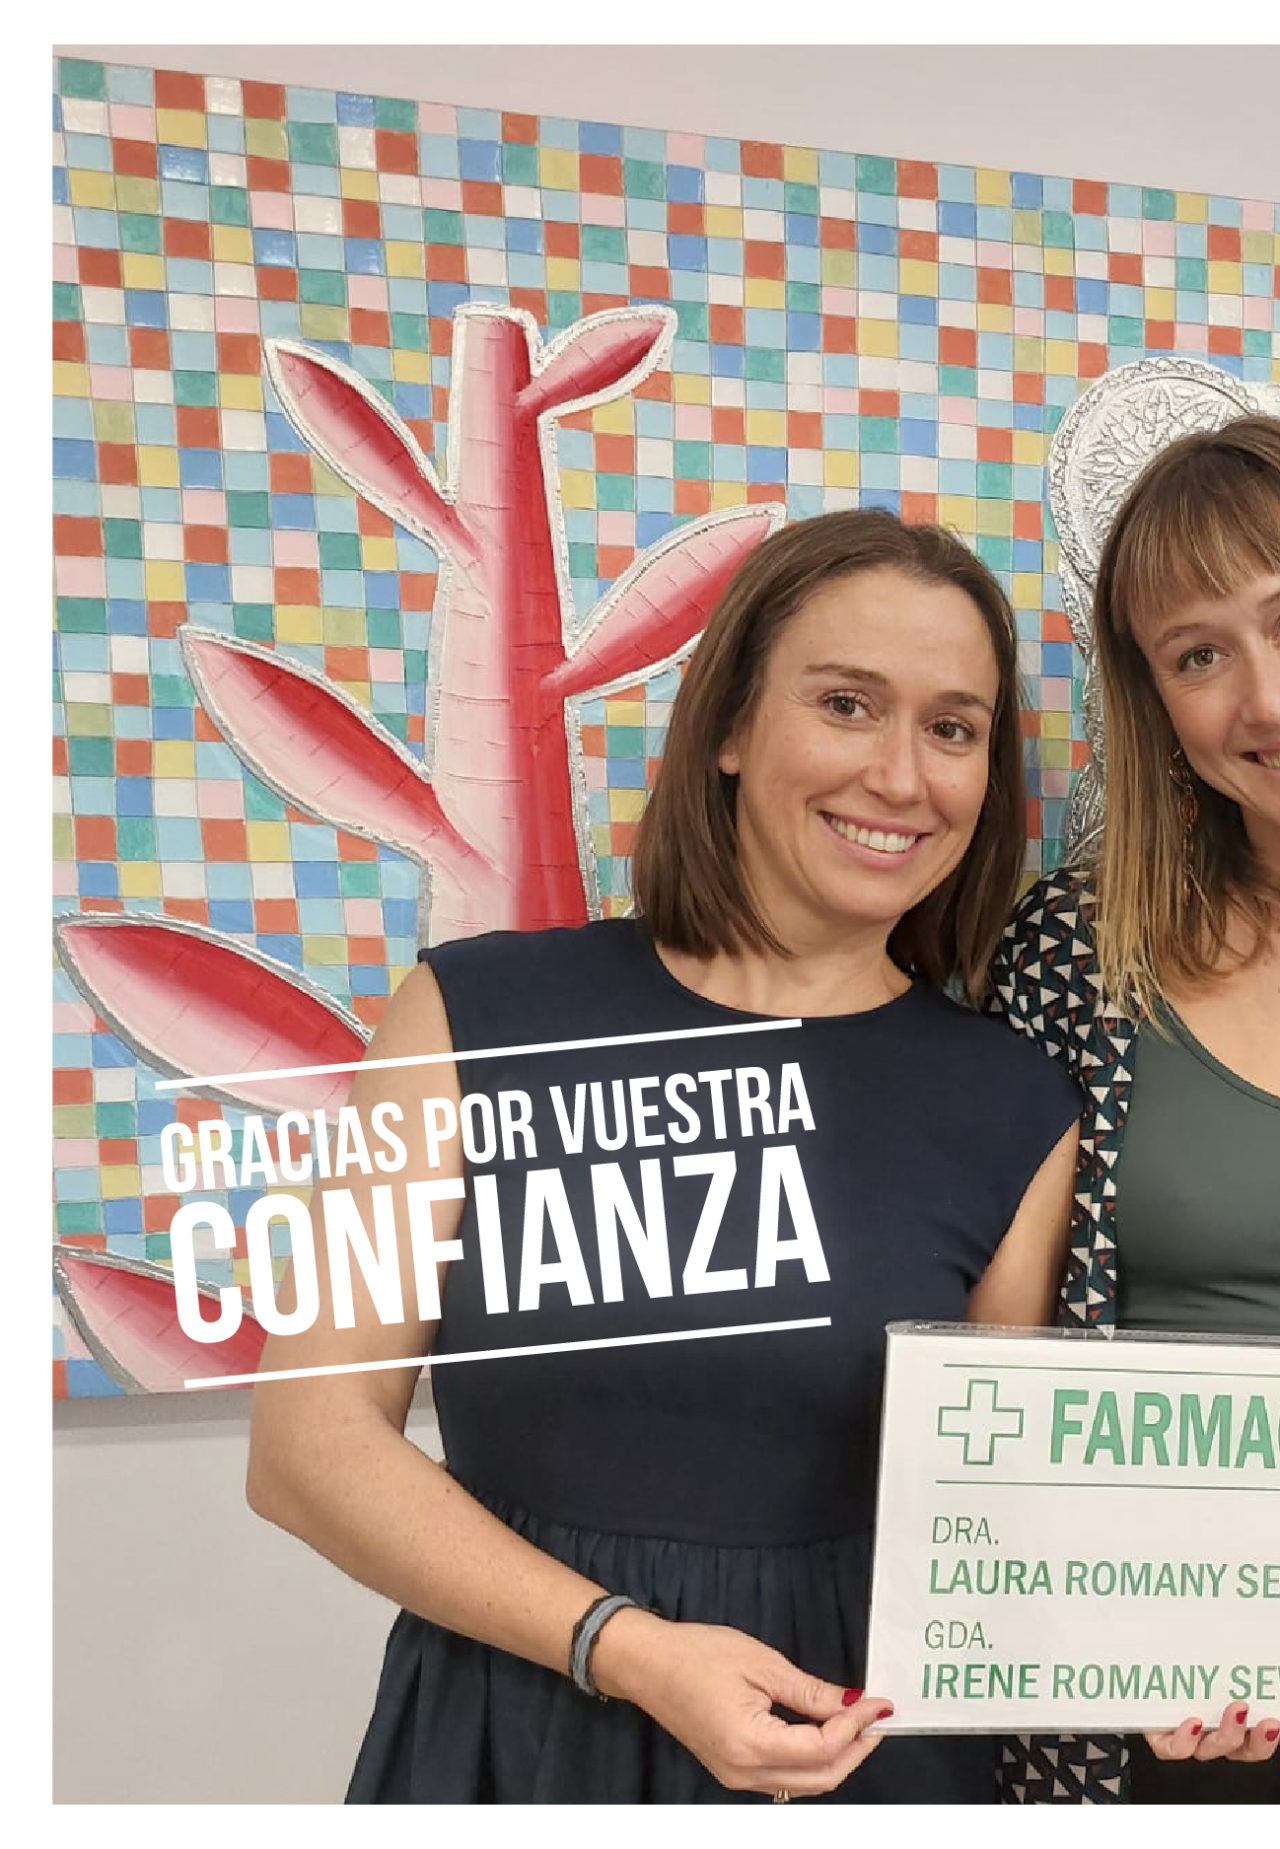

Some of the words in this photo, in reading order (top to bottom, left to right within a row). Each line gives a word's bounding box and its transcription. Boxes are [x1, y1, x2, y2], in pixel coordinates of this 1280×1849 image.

[931, 1516, 999, 1546] DRA.
[928, 1559, 1053, 1596] LAURA
[1065, 1560, 1228, 1599] ROMANY
[924, 1620, 993, 1650] GDA.
[921, 1663, 1040, 1699] IRENE
[1052, 1664, 1220, 1700] ROMANY
